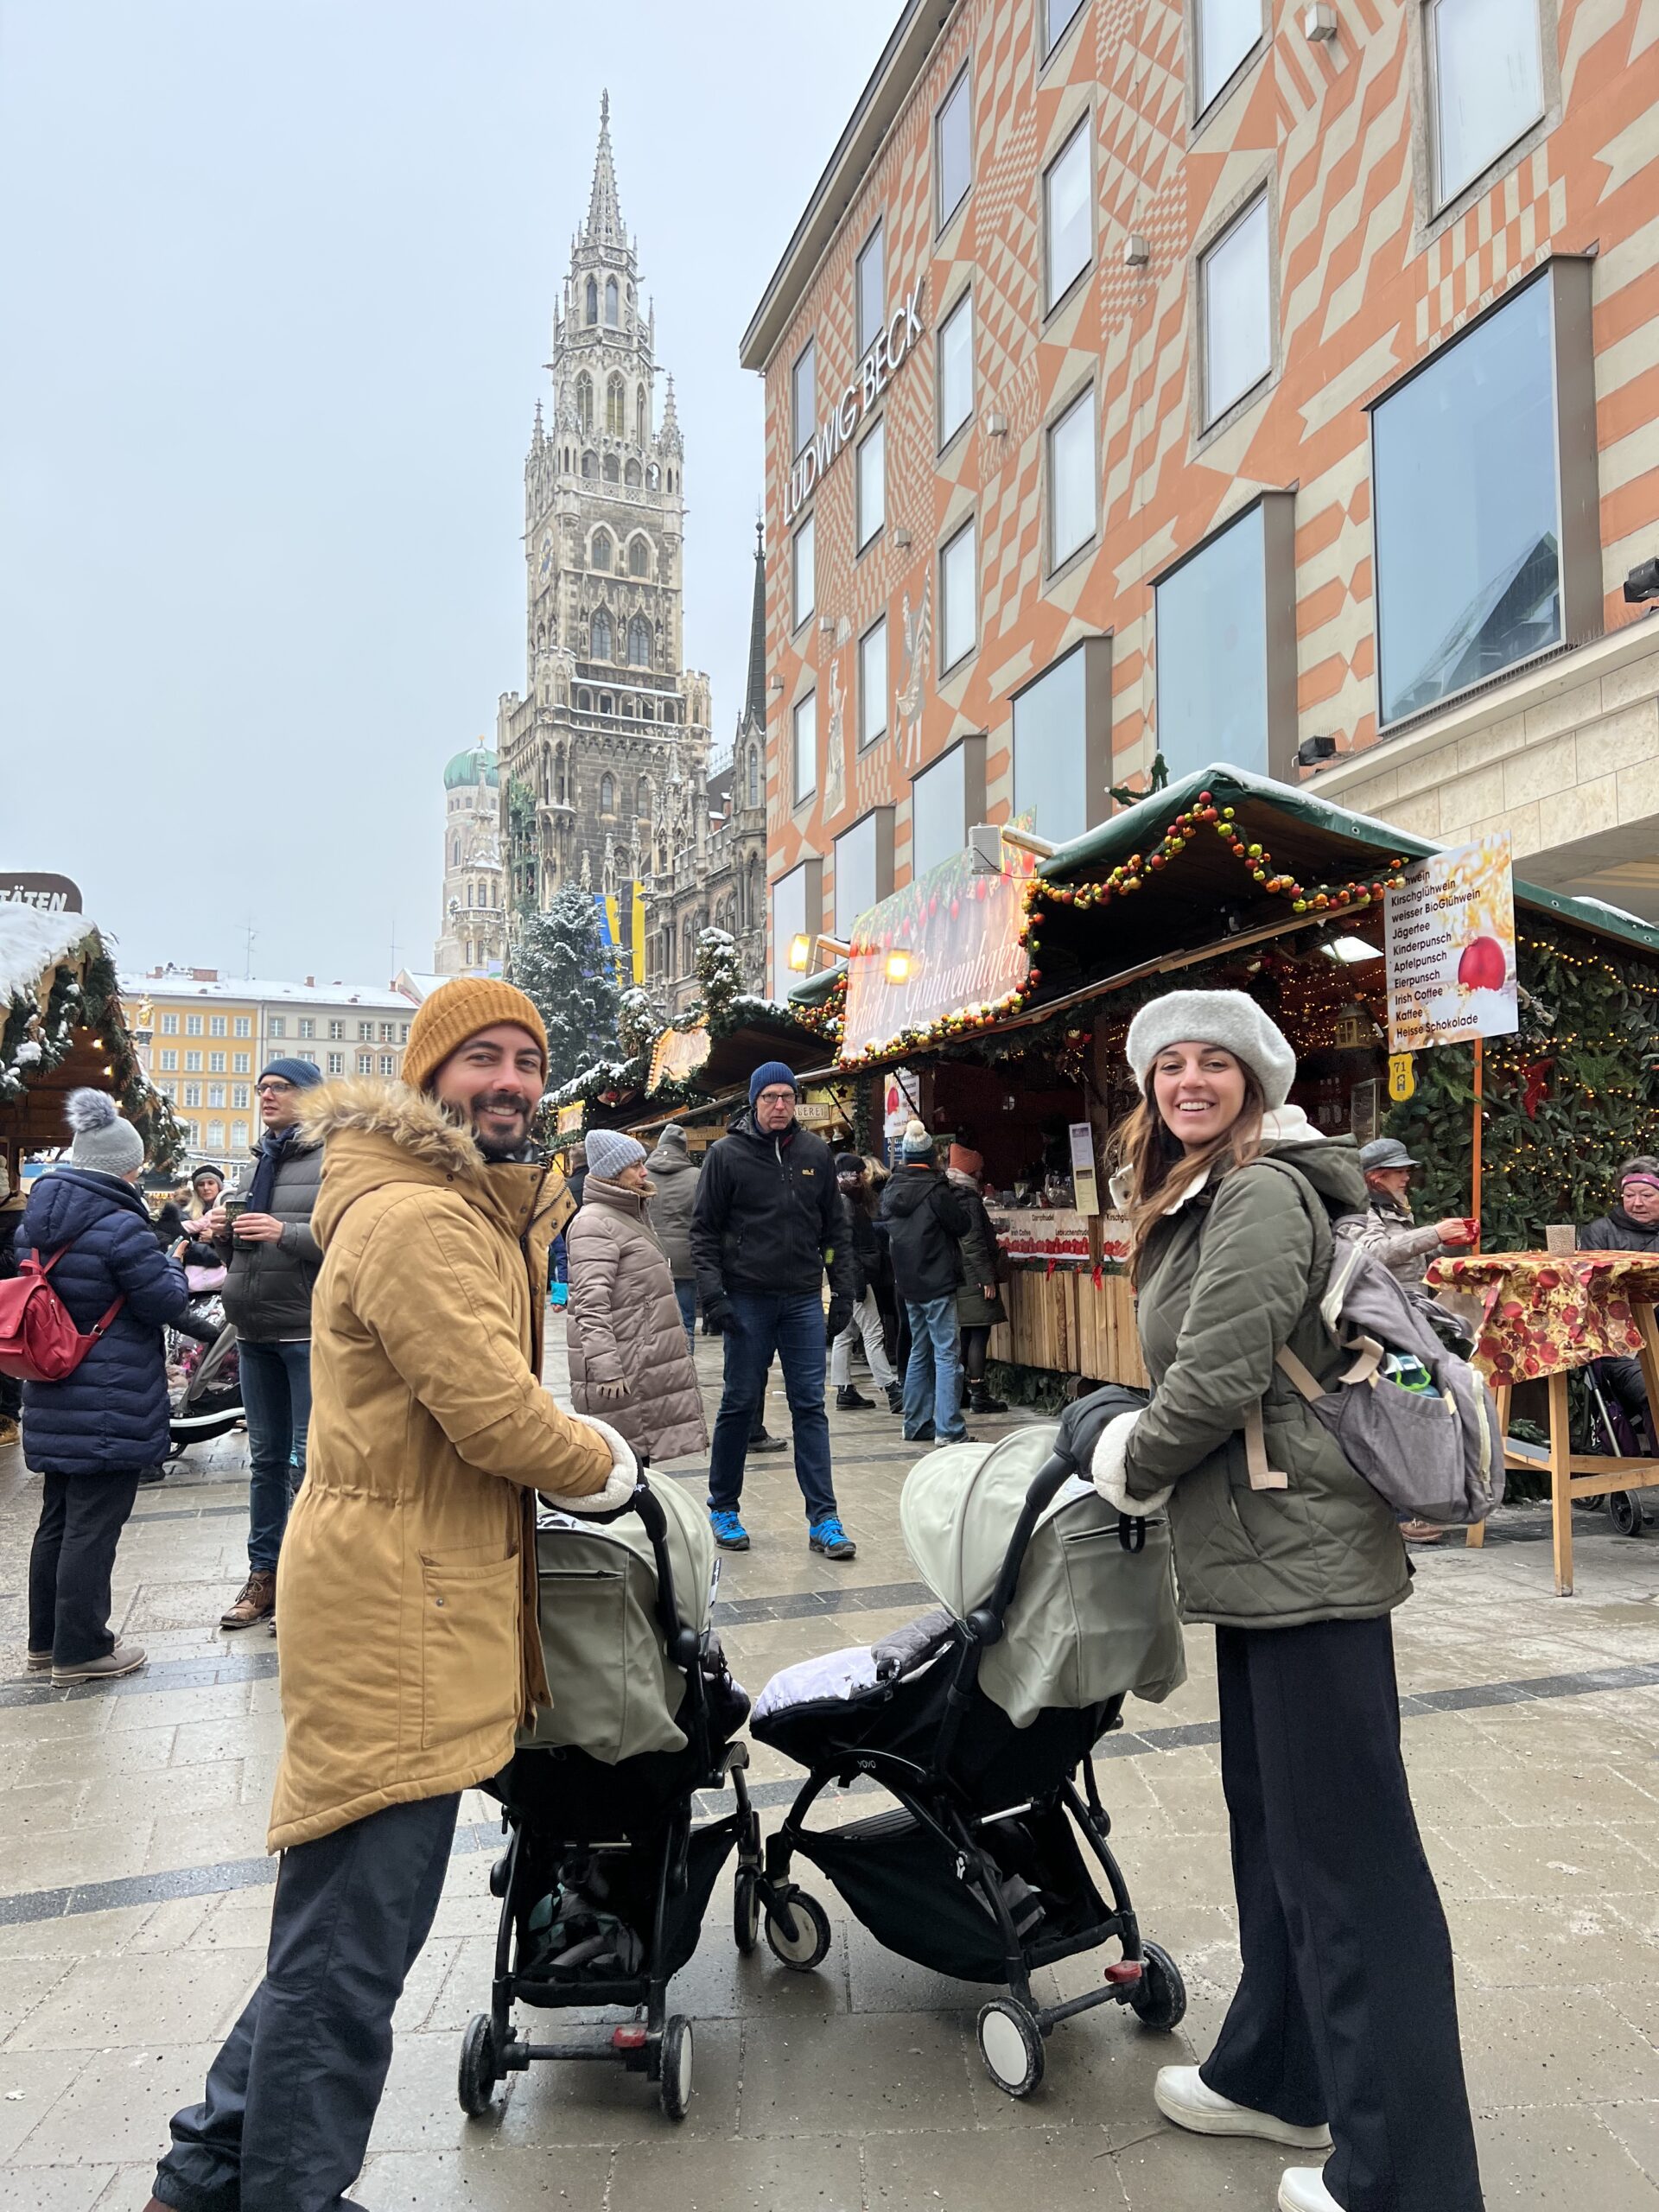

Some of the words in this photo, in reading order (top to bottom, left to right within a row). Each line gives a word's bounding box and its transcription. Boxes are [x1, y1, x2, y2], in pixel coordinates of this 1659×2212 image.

[784, 385, 858, 526] LUDWIG
[863, 276, 925, 414] BECK
[1405, 870, 1430, 887] hwein
[1391, 879, 1456, 907] Kirschglühwein
[1392, 907, 1423, 923] weisser
[1425, 888, 1481, 914] BioGlühwein
[1392, 921, 1431, 940] Jägertee
[1393, 931, 1452, 957] Kinderpunsch
[1394, 950, 1447, 973] Apfelpunsch
[1395, 969, 1440, 990] Eierpunsch
[1395, 994, 1413, 1006] Irish
[1414, 986, 1443, 1001] Coffee
[1395, 1007, 1423, 1022] Kaffee
[1396, 1023, 1424, 1039] Heisse
[1426, 1014, 1478, 1033] Schokolade
[1394, 1061, 1406, 1073] 71
[856, 1759, 876, 1769] YOYO
